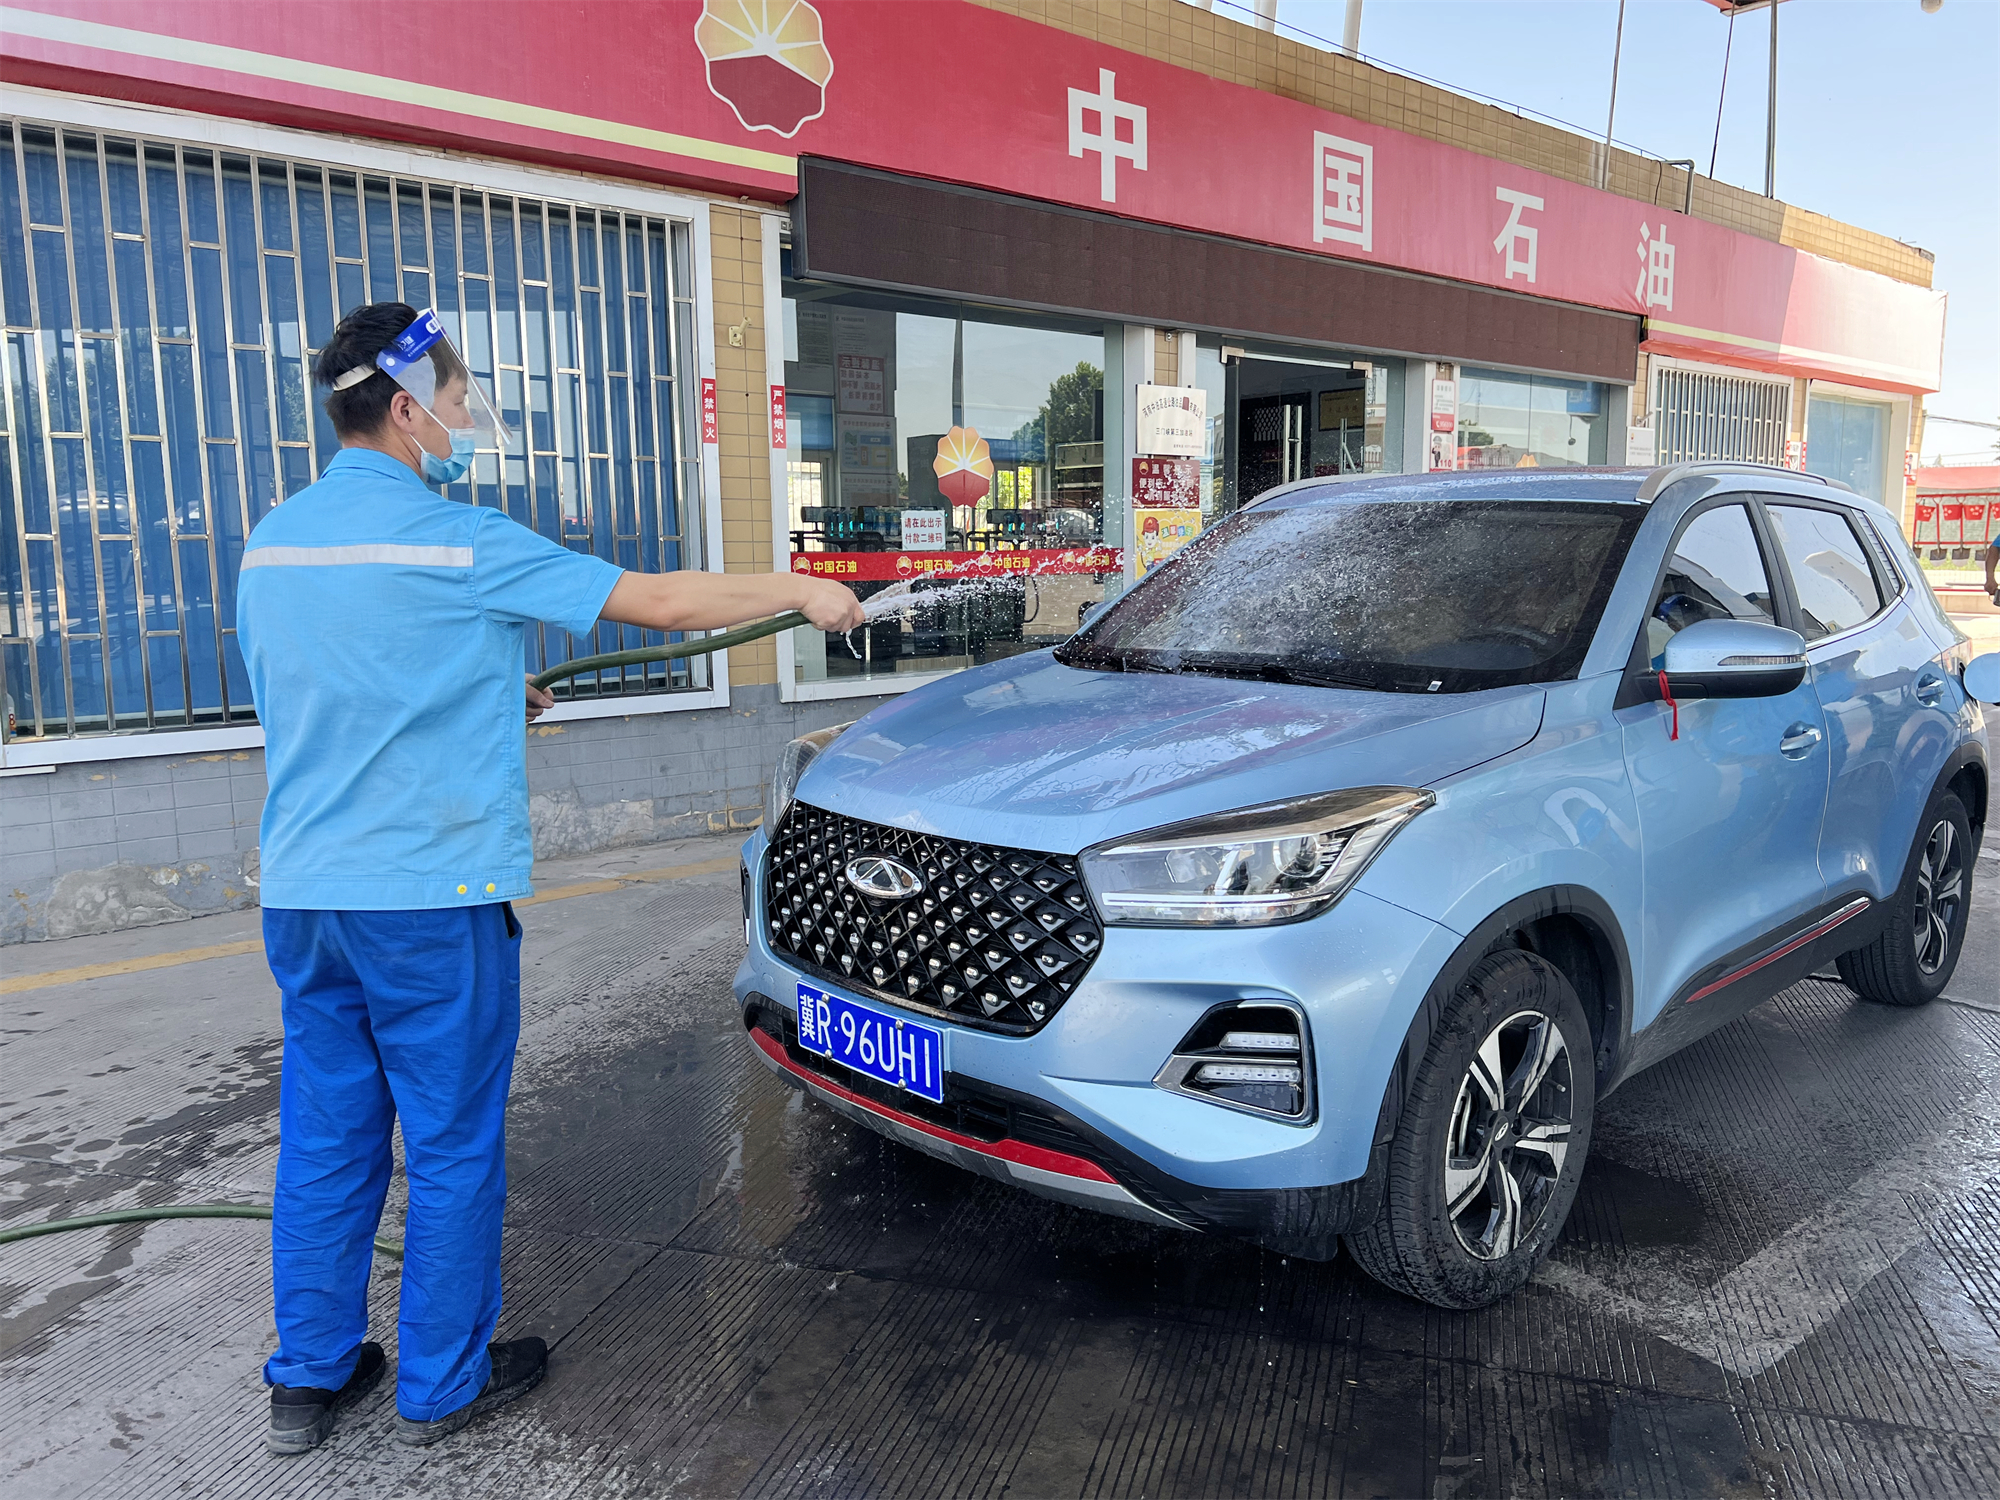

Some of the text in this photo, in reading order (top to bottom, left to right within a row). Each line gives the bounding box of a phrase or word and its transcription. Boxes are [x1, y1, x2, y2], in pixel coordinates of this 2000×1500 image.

[1067, 67, 1676, 312] 中国石油
[704, 383, 715, 439] 严禁烟火
[773, 390, 784, 444] 严禁烟火
[1440, 459, 1452, 468] 110
[905, 517, 942, 528] 请在此出示
[905, 532, 943, 544] 付款二维码
[813, 560, 857, 573] 中国石油
[914, 559, 954, 571] 中国石油
[994, 557, 1031, 569] 中国石油
